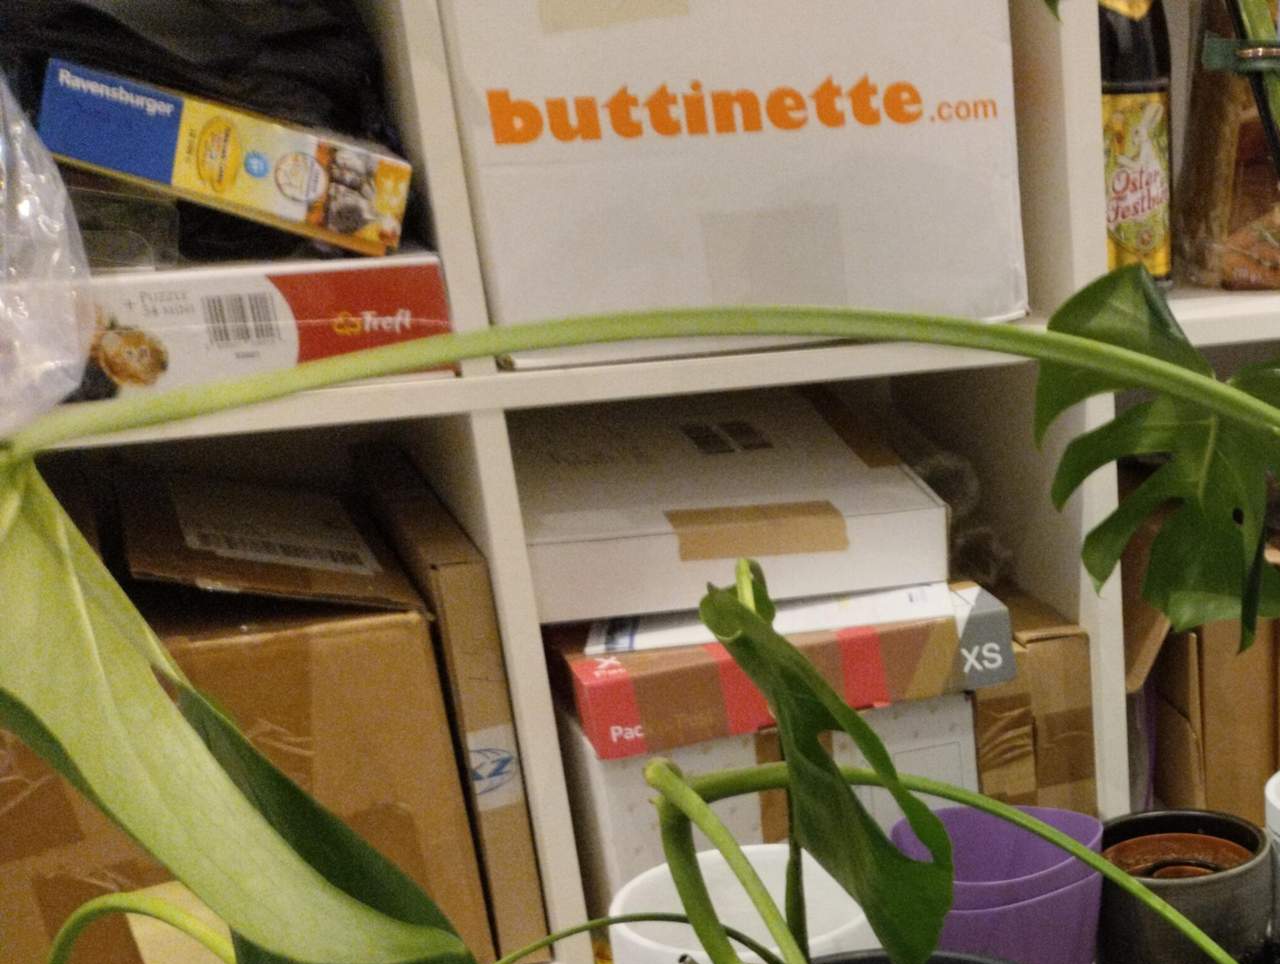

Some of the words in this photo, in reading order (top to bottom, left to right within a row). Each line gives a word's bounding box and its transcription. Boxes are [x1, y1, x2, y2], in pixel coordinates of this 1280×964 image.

[58, 67, 175, 117] Ravensburger
[486, 74, 998, 145] buttinette.com
[960, 643, 1003, 673] XS
